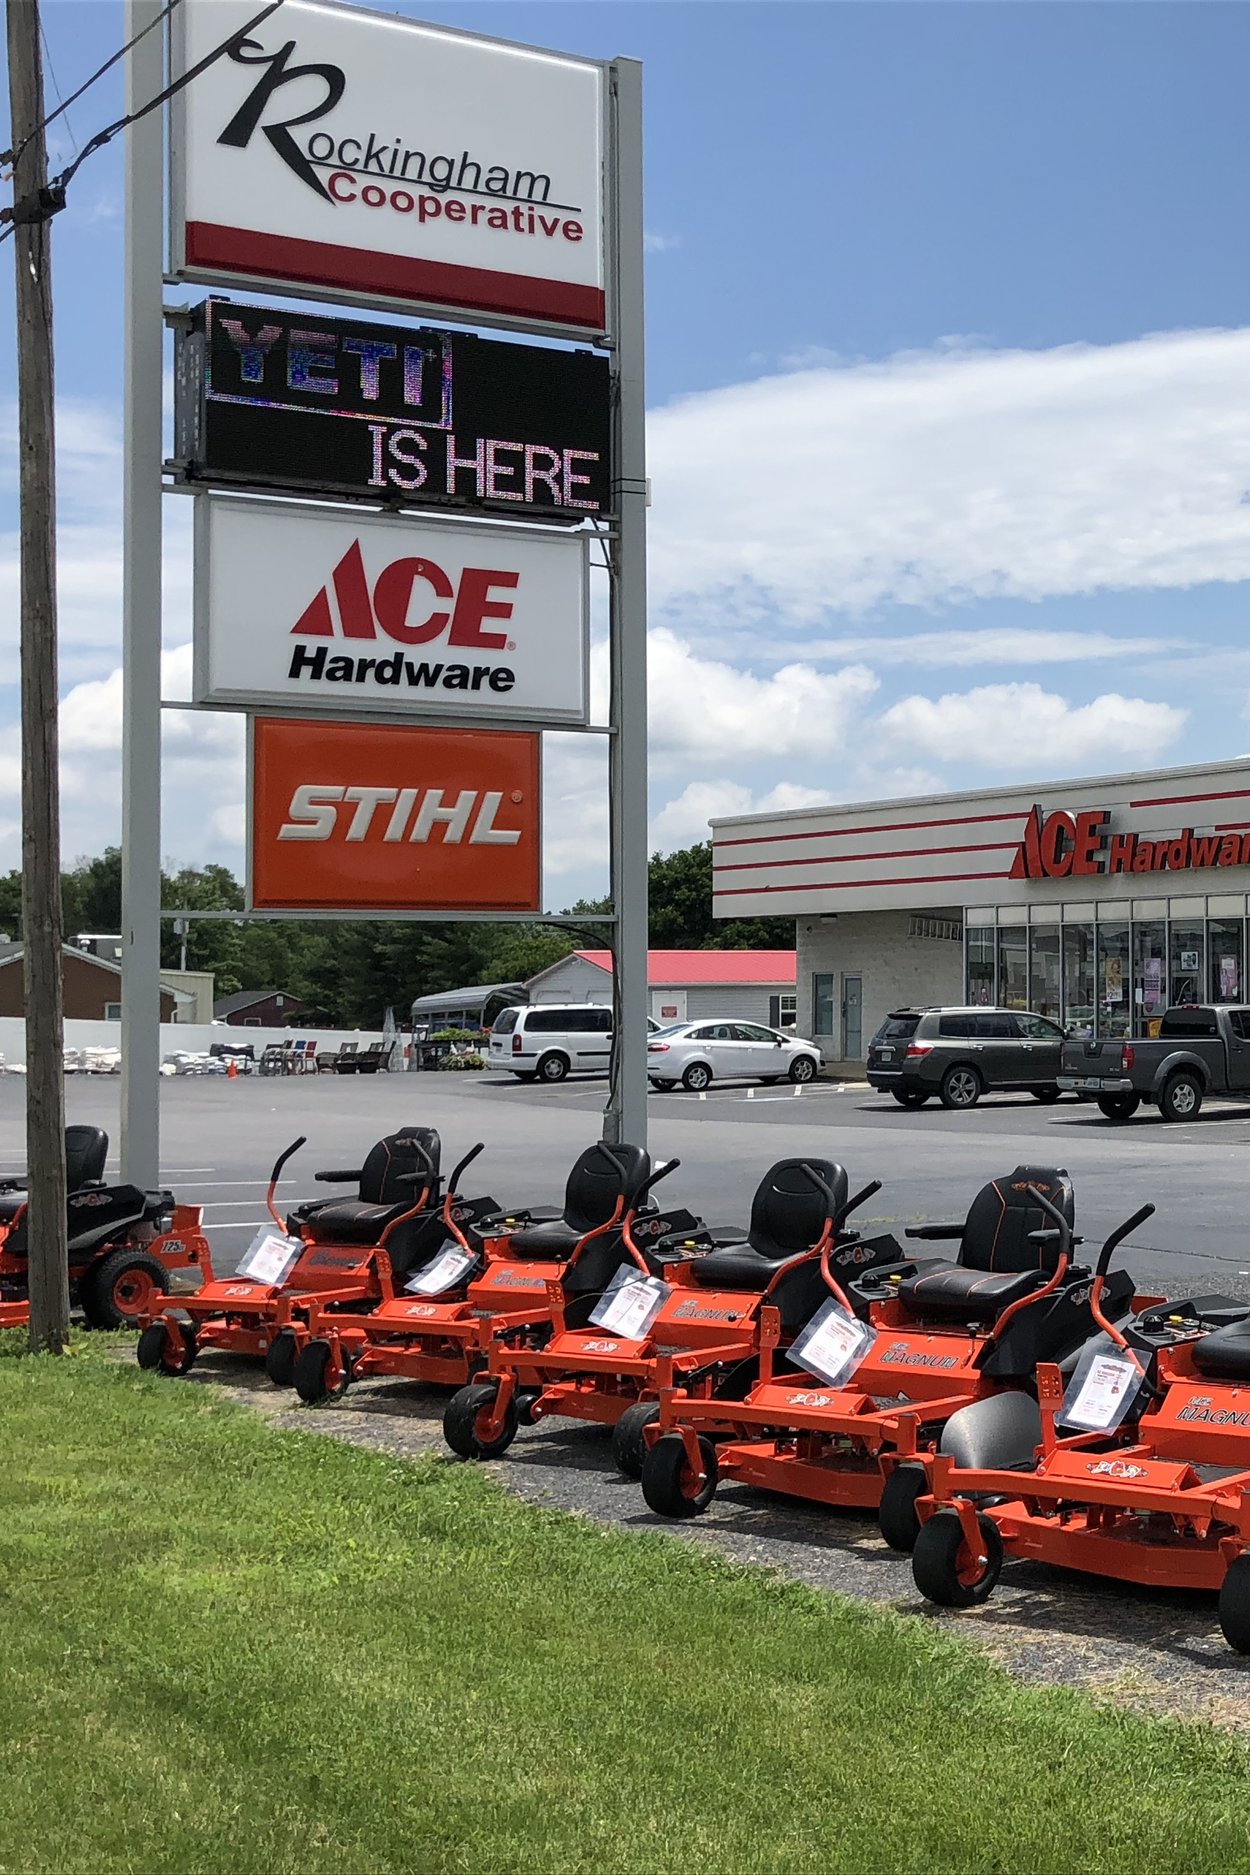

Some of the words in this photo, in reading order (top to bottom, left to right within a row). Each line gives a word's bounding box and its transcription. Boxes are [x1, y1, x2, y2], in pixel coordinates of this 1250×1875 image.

[216, 38, 551, 206] Rockingham
[326, 171, 584, 243] Cooperative
[219, 318, 426, 407] YETI
[367, 425, 428, 490] IS
[446, 434, 600, 510] HERE
[290, 537, 520, 650] ACE
[288, 644, 516, 693] Hardware
[276, 784, 521, 846] STIHL
[1008, 804, 1110, 880] ACE
[878, 1350, 961, 1370] MAGNUM
